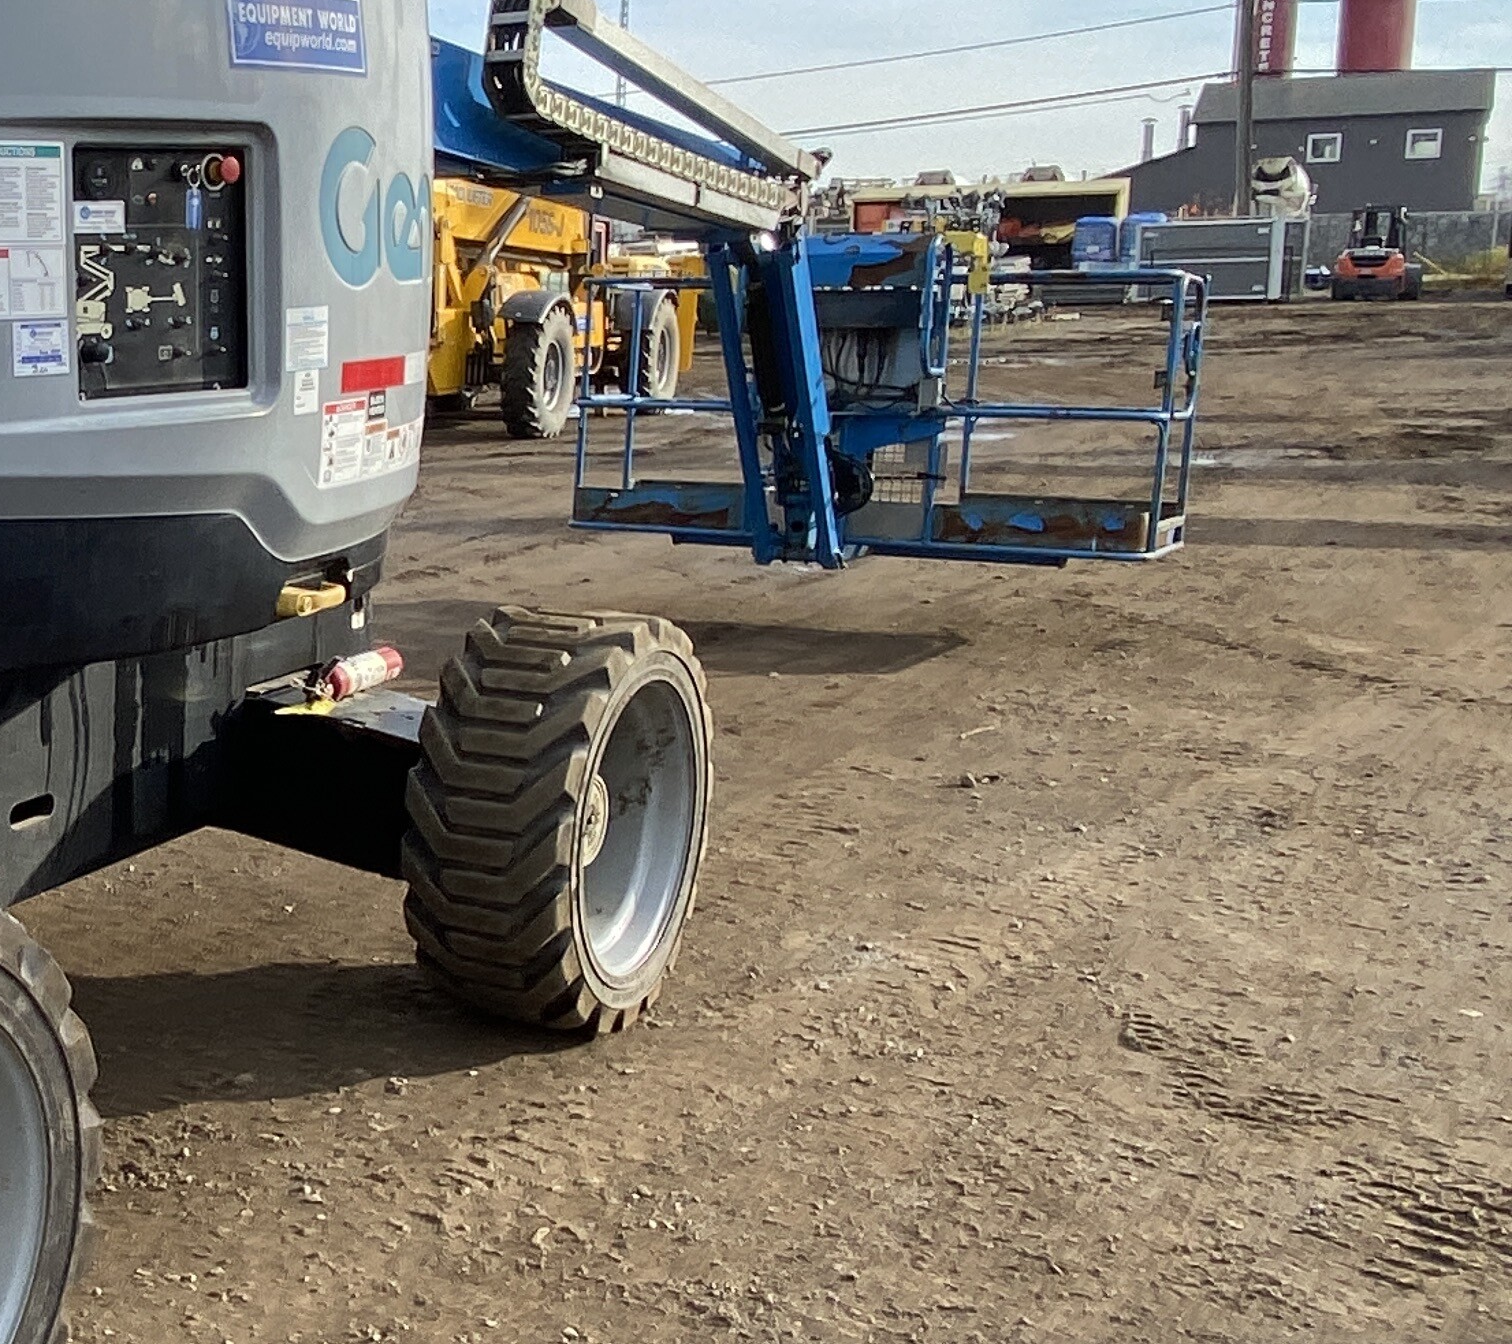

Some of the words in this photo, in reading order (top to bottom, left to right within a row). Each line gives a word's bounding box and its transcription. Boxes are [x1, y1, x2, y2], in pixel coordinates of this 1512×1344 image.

[238, 2, 313, 29] EQUIPMENT
[317, 9, 357, 33] WORLD
[264, 29, 357, 54] equipworld.com
